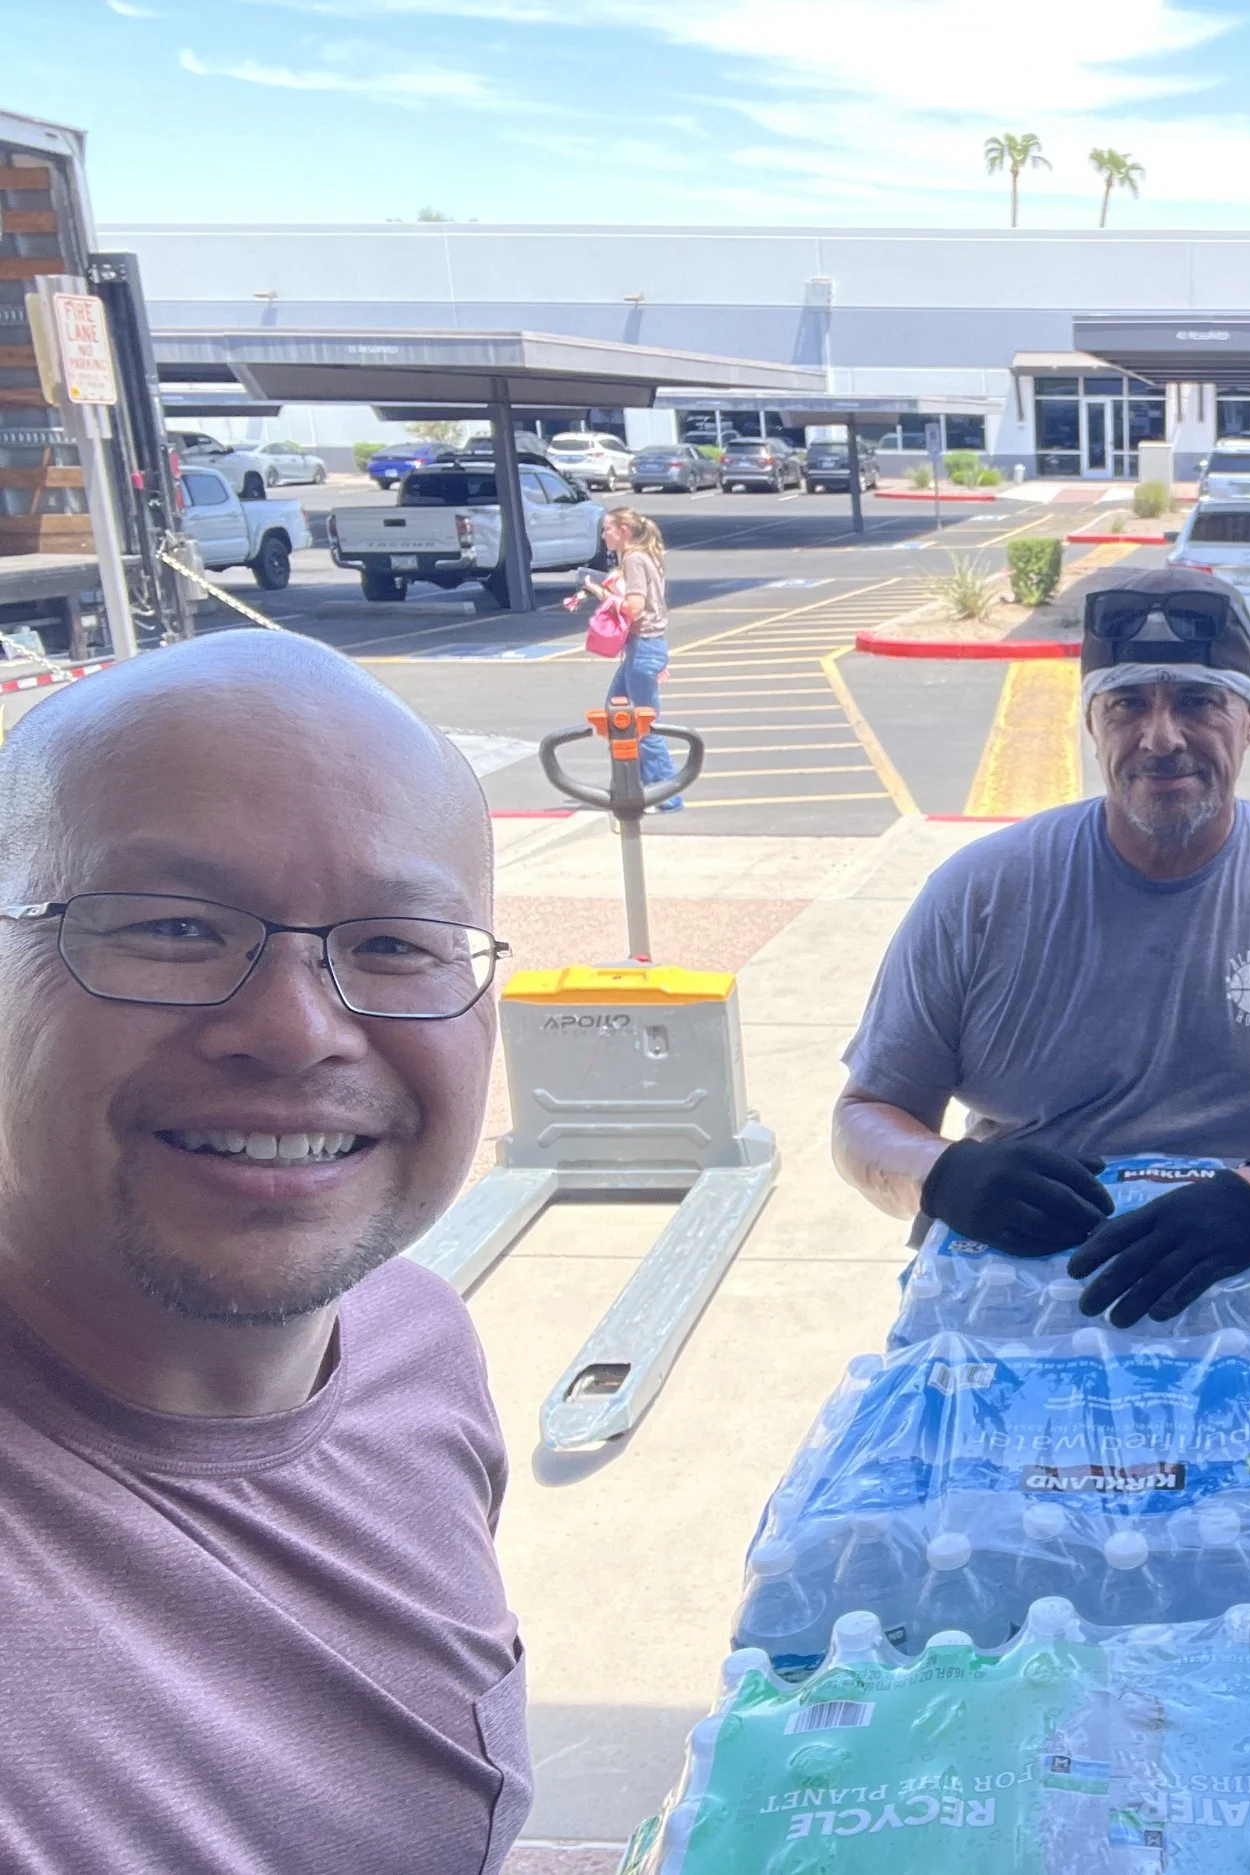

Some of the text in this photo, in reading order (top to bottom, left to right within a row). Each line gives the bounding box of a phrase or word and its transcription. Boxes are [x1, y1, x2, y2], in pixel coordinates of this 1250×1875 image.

[64, 301, 95, 322] FIRE
[64, 322, 98, 342] LANE
[543, 1014, 631, 1030] APOLLO
[1123, 1168, 1217, 1179] KIRKLAN
[971, 1429, 1088, 1453] water
[1026, 1473, 1177, 1492] KIRKLAND
[760, 1762, 1035, 1814] FOR THE PLANET
[786, 1794, 997, 1841] RECYCLE
